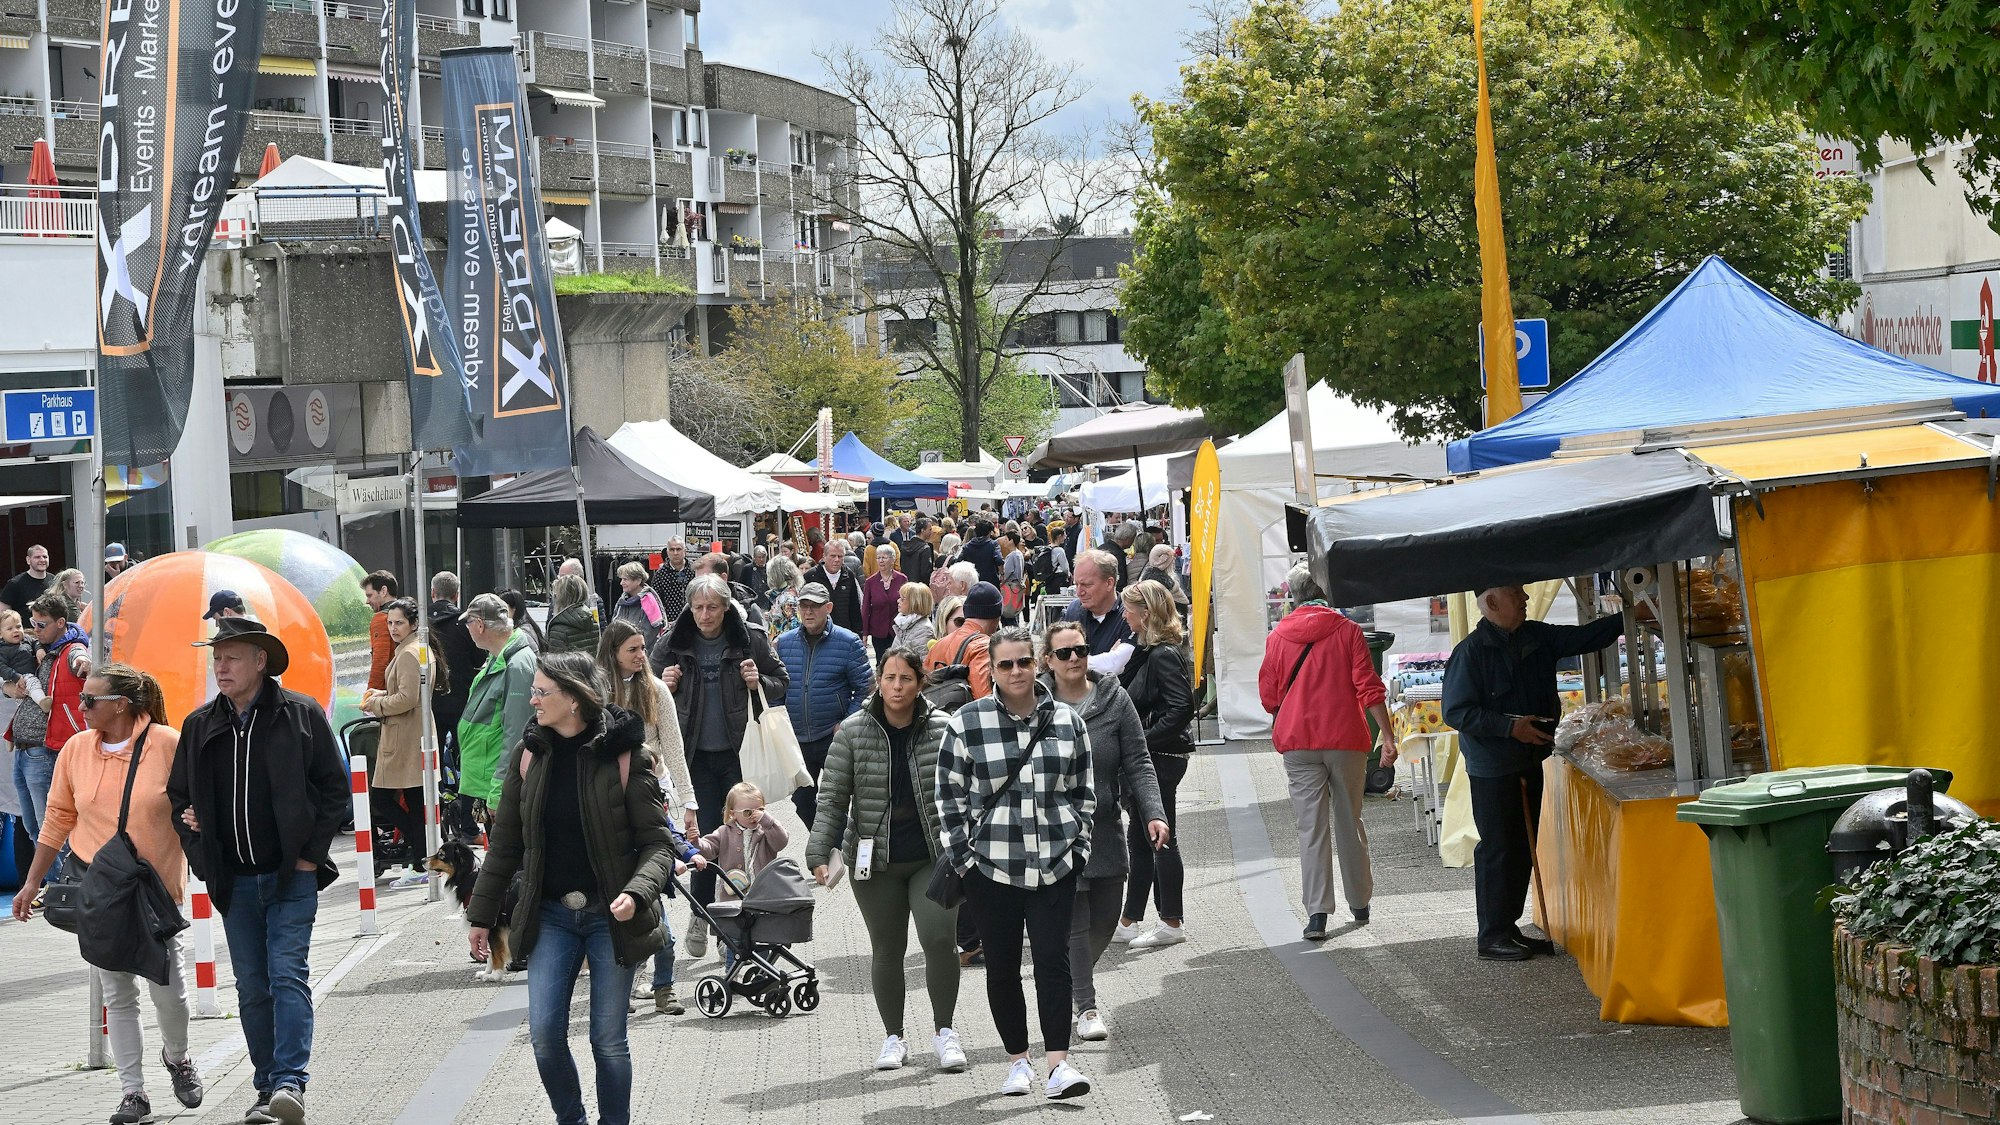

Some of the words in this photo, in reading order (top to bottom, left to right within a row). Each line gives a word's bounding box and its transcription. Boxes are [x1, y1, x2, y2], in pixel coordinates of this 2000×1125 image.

[134, 0, 160, 79] Marke
[131, 105, 156, 193] Events
[379, 0, 430, 357] XDREAM
[41, 394, 73, 408] Parkhaus
[75, 414, 83, 432] P
[1011, 462, 1020, 470] 30
[352, 486, 403, 503] Wäschehaus
[1200, 480, 1214, 563] JEMAKO
